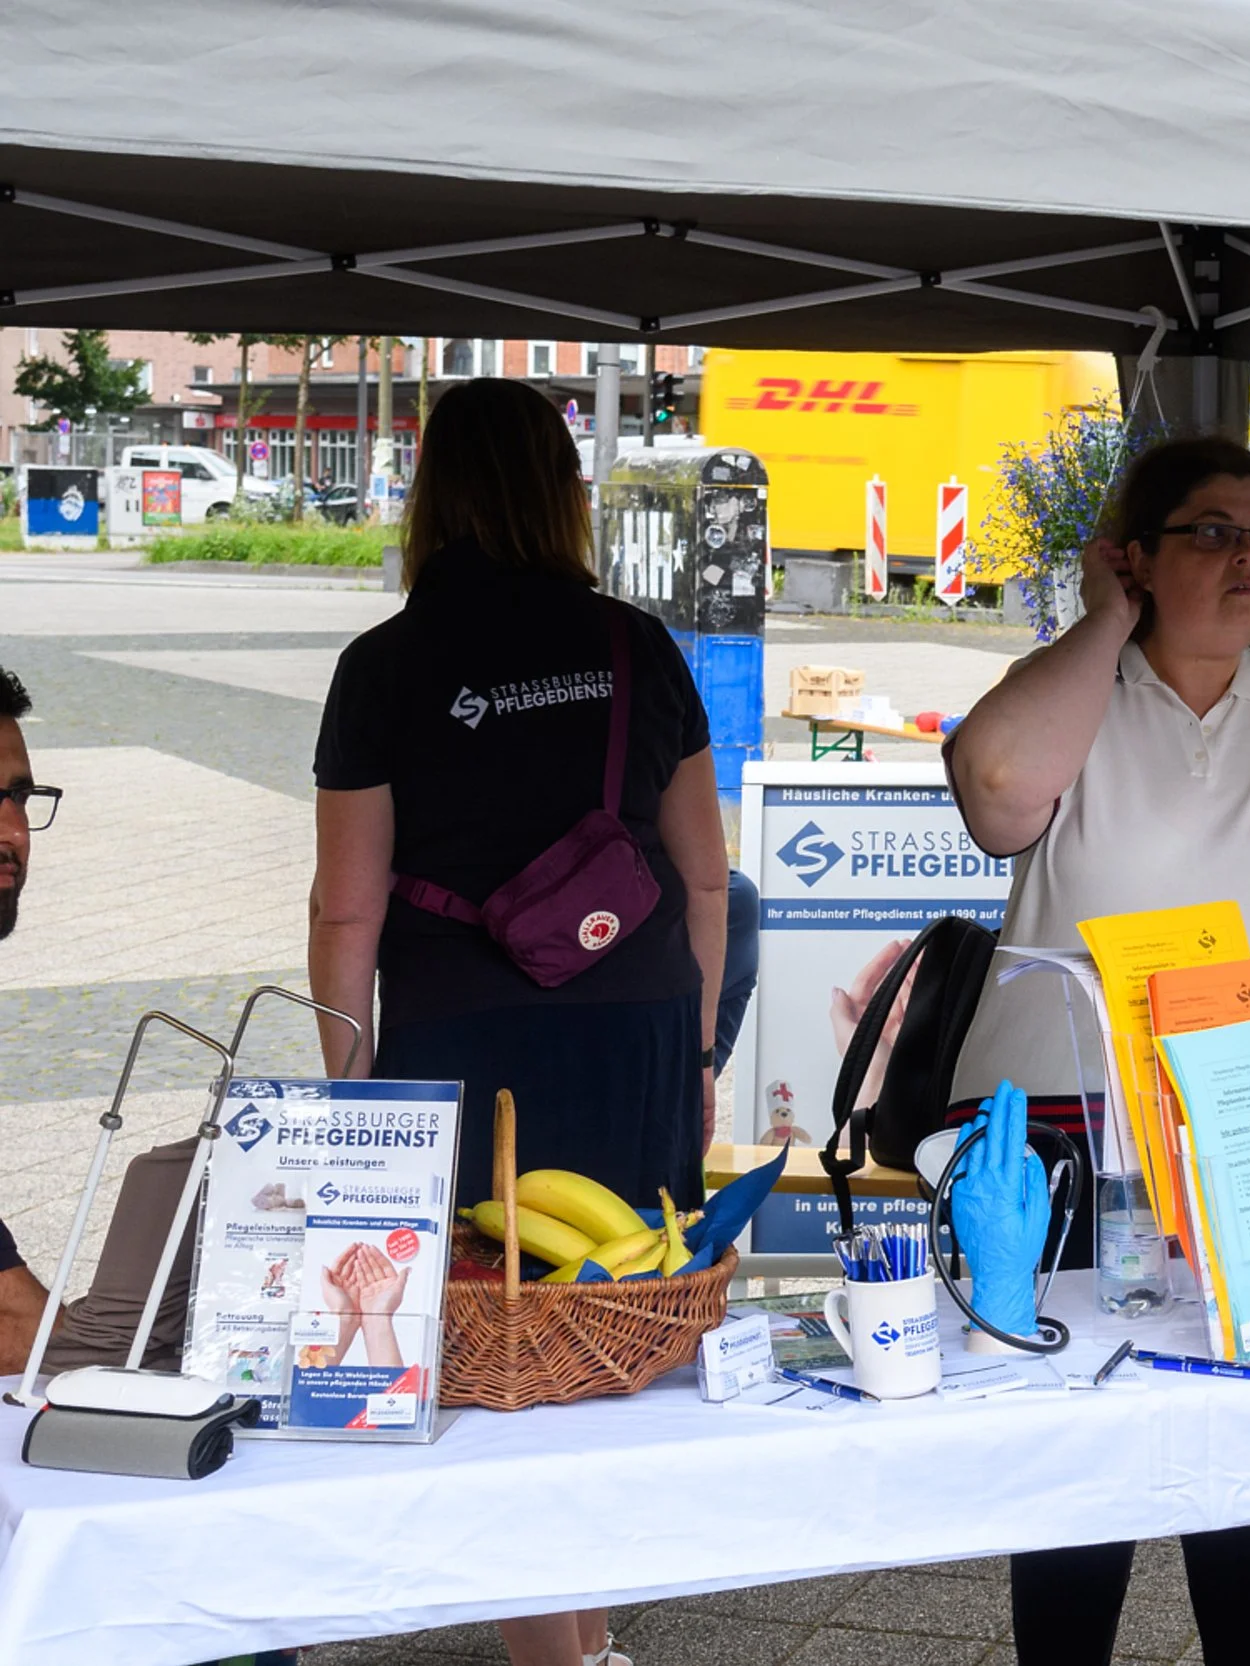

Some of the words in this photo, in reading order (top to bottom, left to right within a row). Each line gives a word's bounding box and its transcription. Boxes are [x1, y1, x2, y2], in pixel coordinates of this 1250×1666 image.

[753, 377, 890, 415] DHL
[494, 684, 613, 715] PFLEGEDIENST
[865, 789, 936, 801] Kranken-
[851, 854, 1014, 877] PFLEGEDIE
[767, 908, 783, 919] Ihr
[786, 908, 850, 919] ambulanter
[852, 908, 923, 921] Pflegedienst
[926, 908, 947, 919] seit
[950, 908, 976, 919] 1990
[979, 908, 998, 919] auf
[276, 1127, 439, 1148] PFLEGEDIENST
[278, 1156, 319, 1166] Unsere
[342, 1194, 421, 1204] PFLEGEDIENST
[795, 1199, 811, 1212] in
[817, 1200, 877, 1212] unere
[882, 1199, 932, 1215] pfleg
[226, 1223, 303, 1234] Pflegeleistungen
